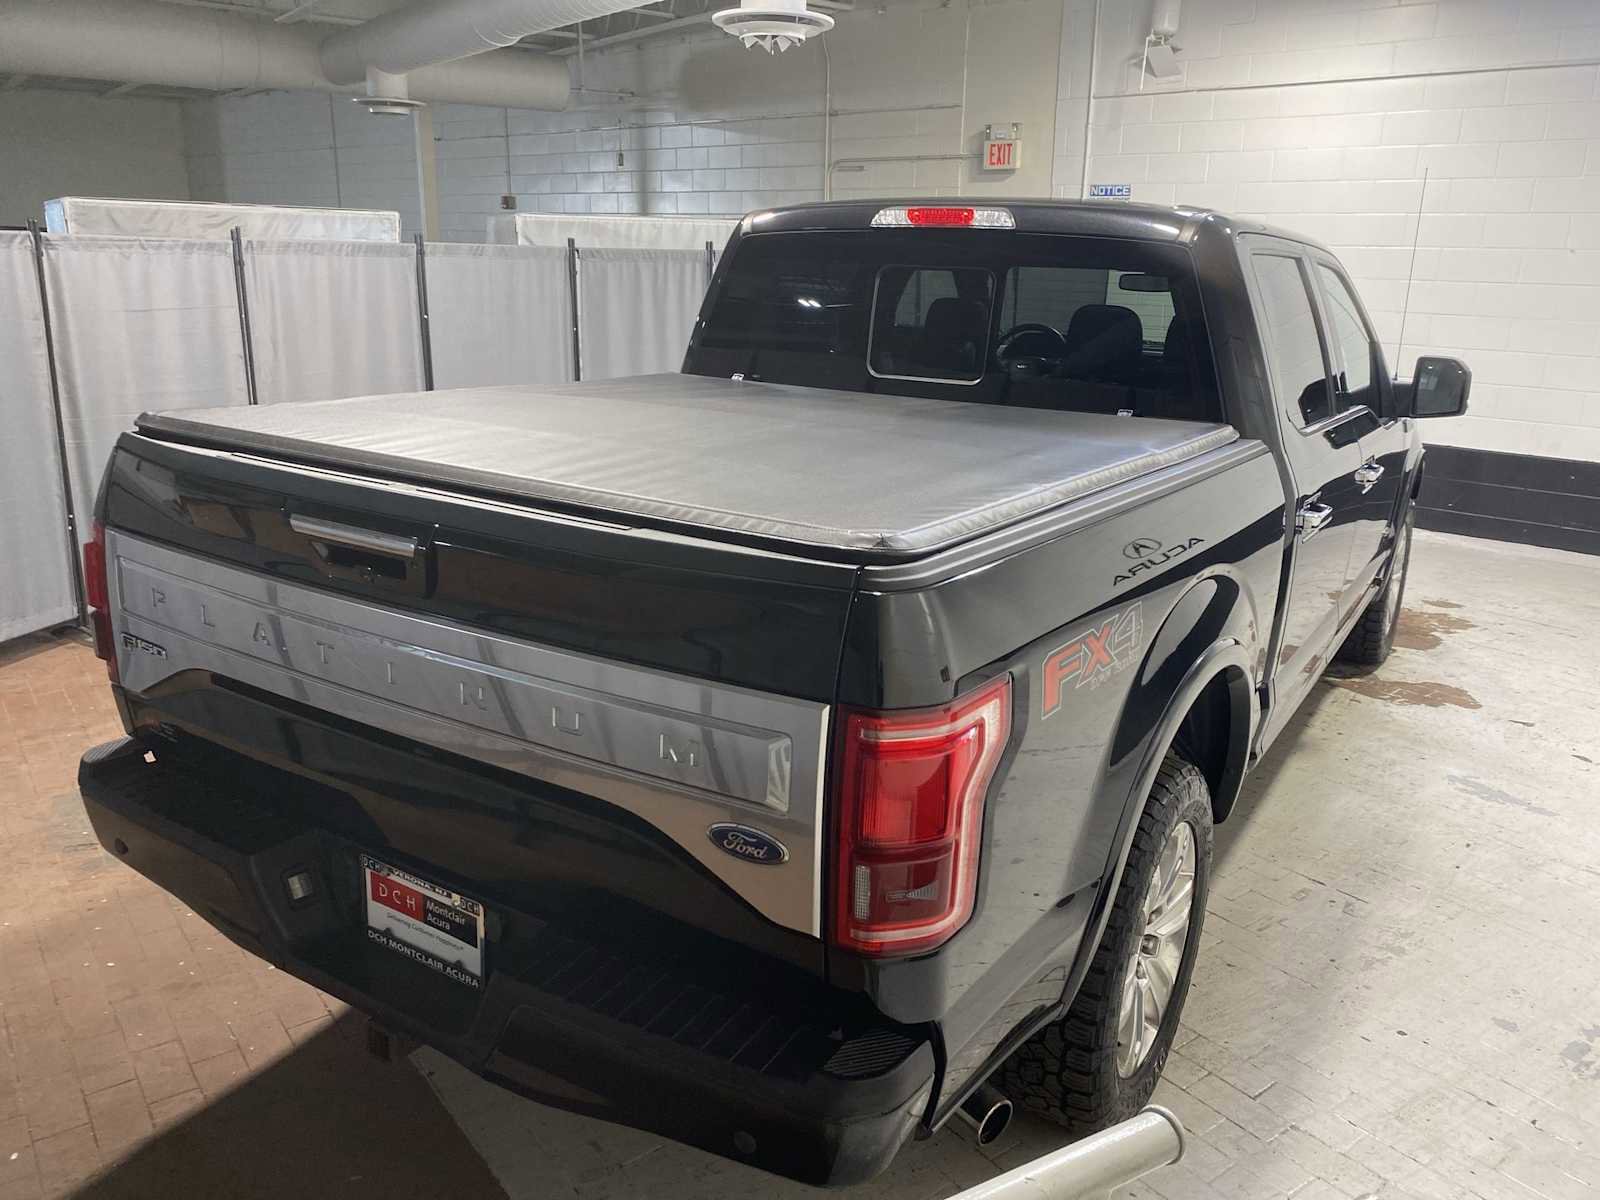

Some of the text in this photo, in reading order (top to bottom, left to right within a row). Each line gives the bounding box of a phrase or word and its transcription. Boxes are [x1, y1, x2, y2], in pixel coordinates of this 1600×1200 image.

[989, 143, 1013, 166] EXIT
[1090, 185, 1130, 196] NOTICE
[1041, 601, 1144, 720] FX4
[151, 587, 702, 768] PLATINUM
[723, 831, 769, 859] Ford
[379, 883, 416, 911] DCH
[426, 900, 465, 925] Montclair
[426, 913, 451, 931] Acura
[368, 930, 387, 945] DCH
[388, 938, 444, 971] MONTCLAIR
[445, 965, 479, 989] ACURA
